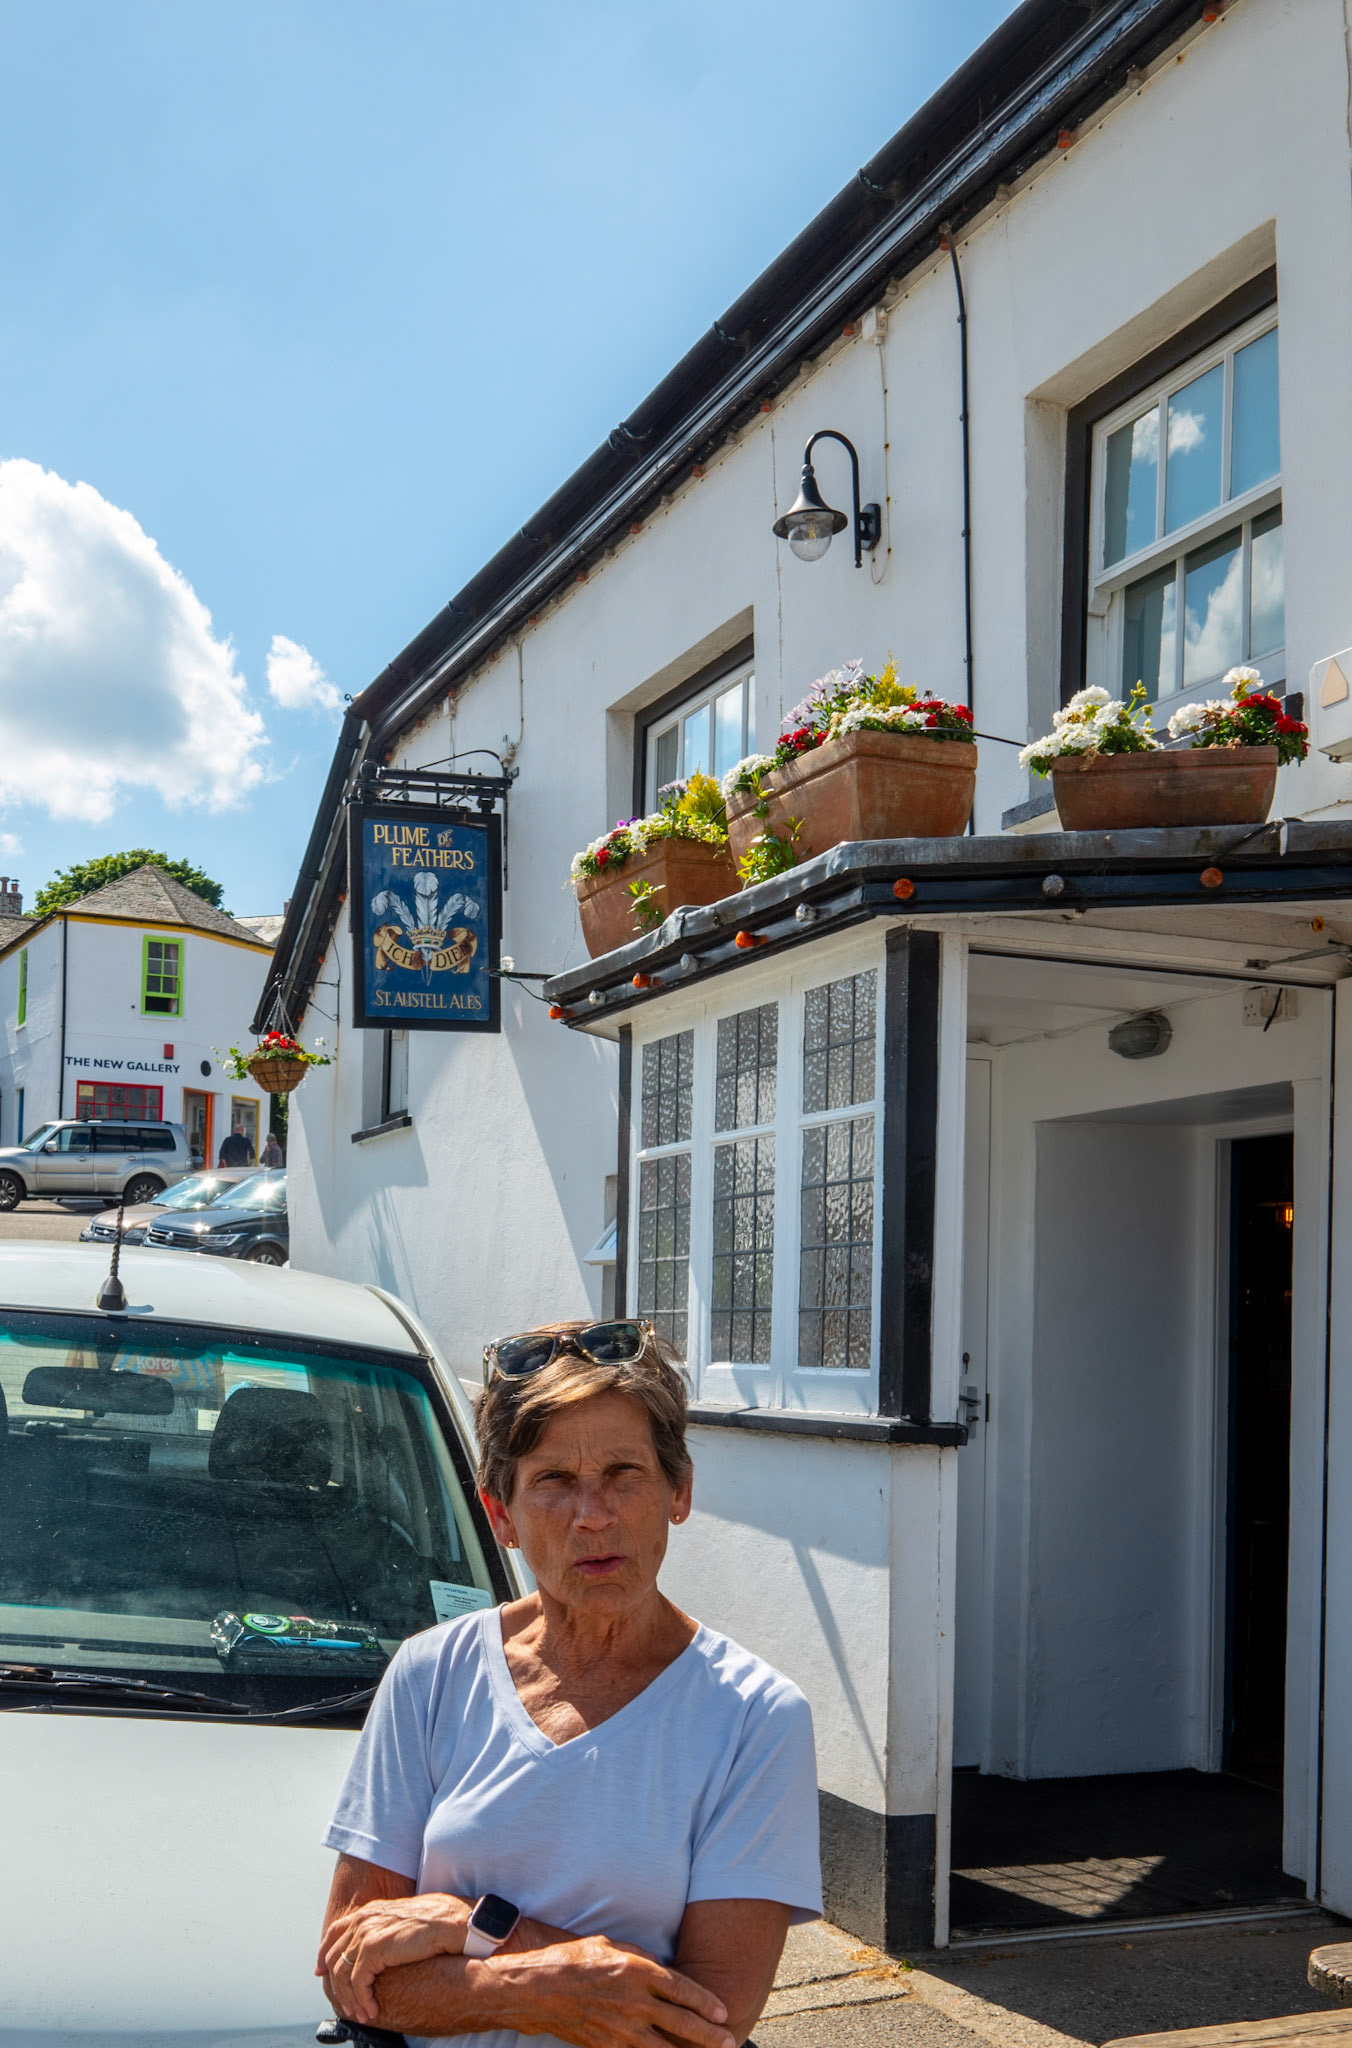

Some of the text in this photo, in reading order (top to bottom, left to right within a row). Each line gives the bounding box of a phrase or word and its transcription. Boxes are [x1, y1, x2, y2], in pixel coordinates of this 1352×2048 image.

[373, 824, 430, 846] PLUME
[392, 847, 475, 870] FEATHERS
[386, 943, 414, 966] ICH
[393, 991, 447, 1008] AUSTELL
[449, 993, 482, 1010] ALES
[65, 1056, 180, 1073] THE NEW GALLERY
